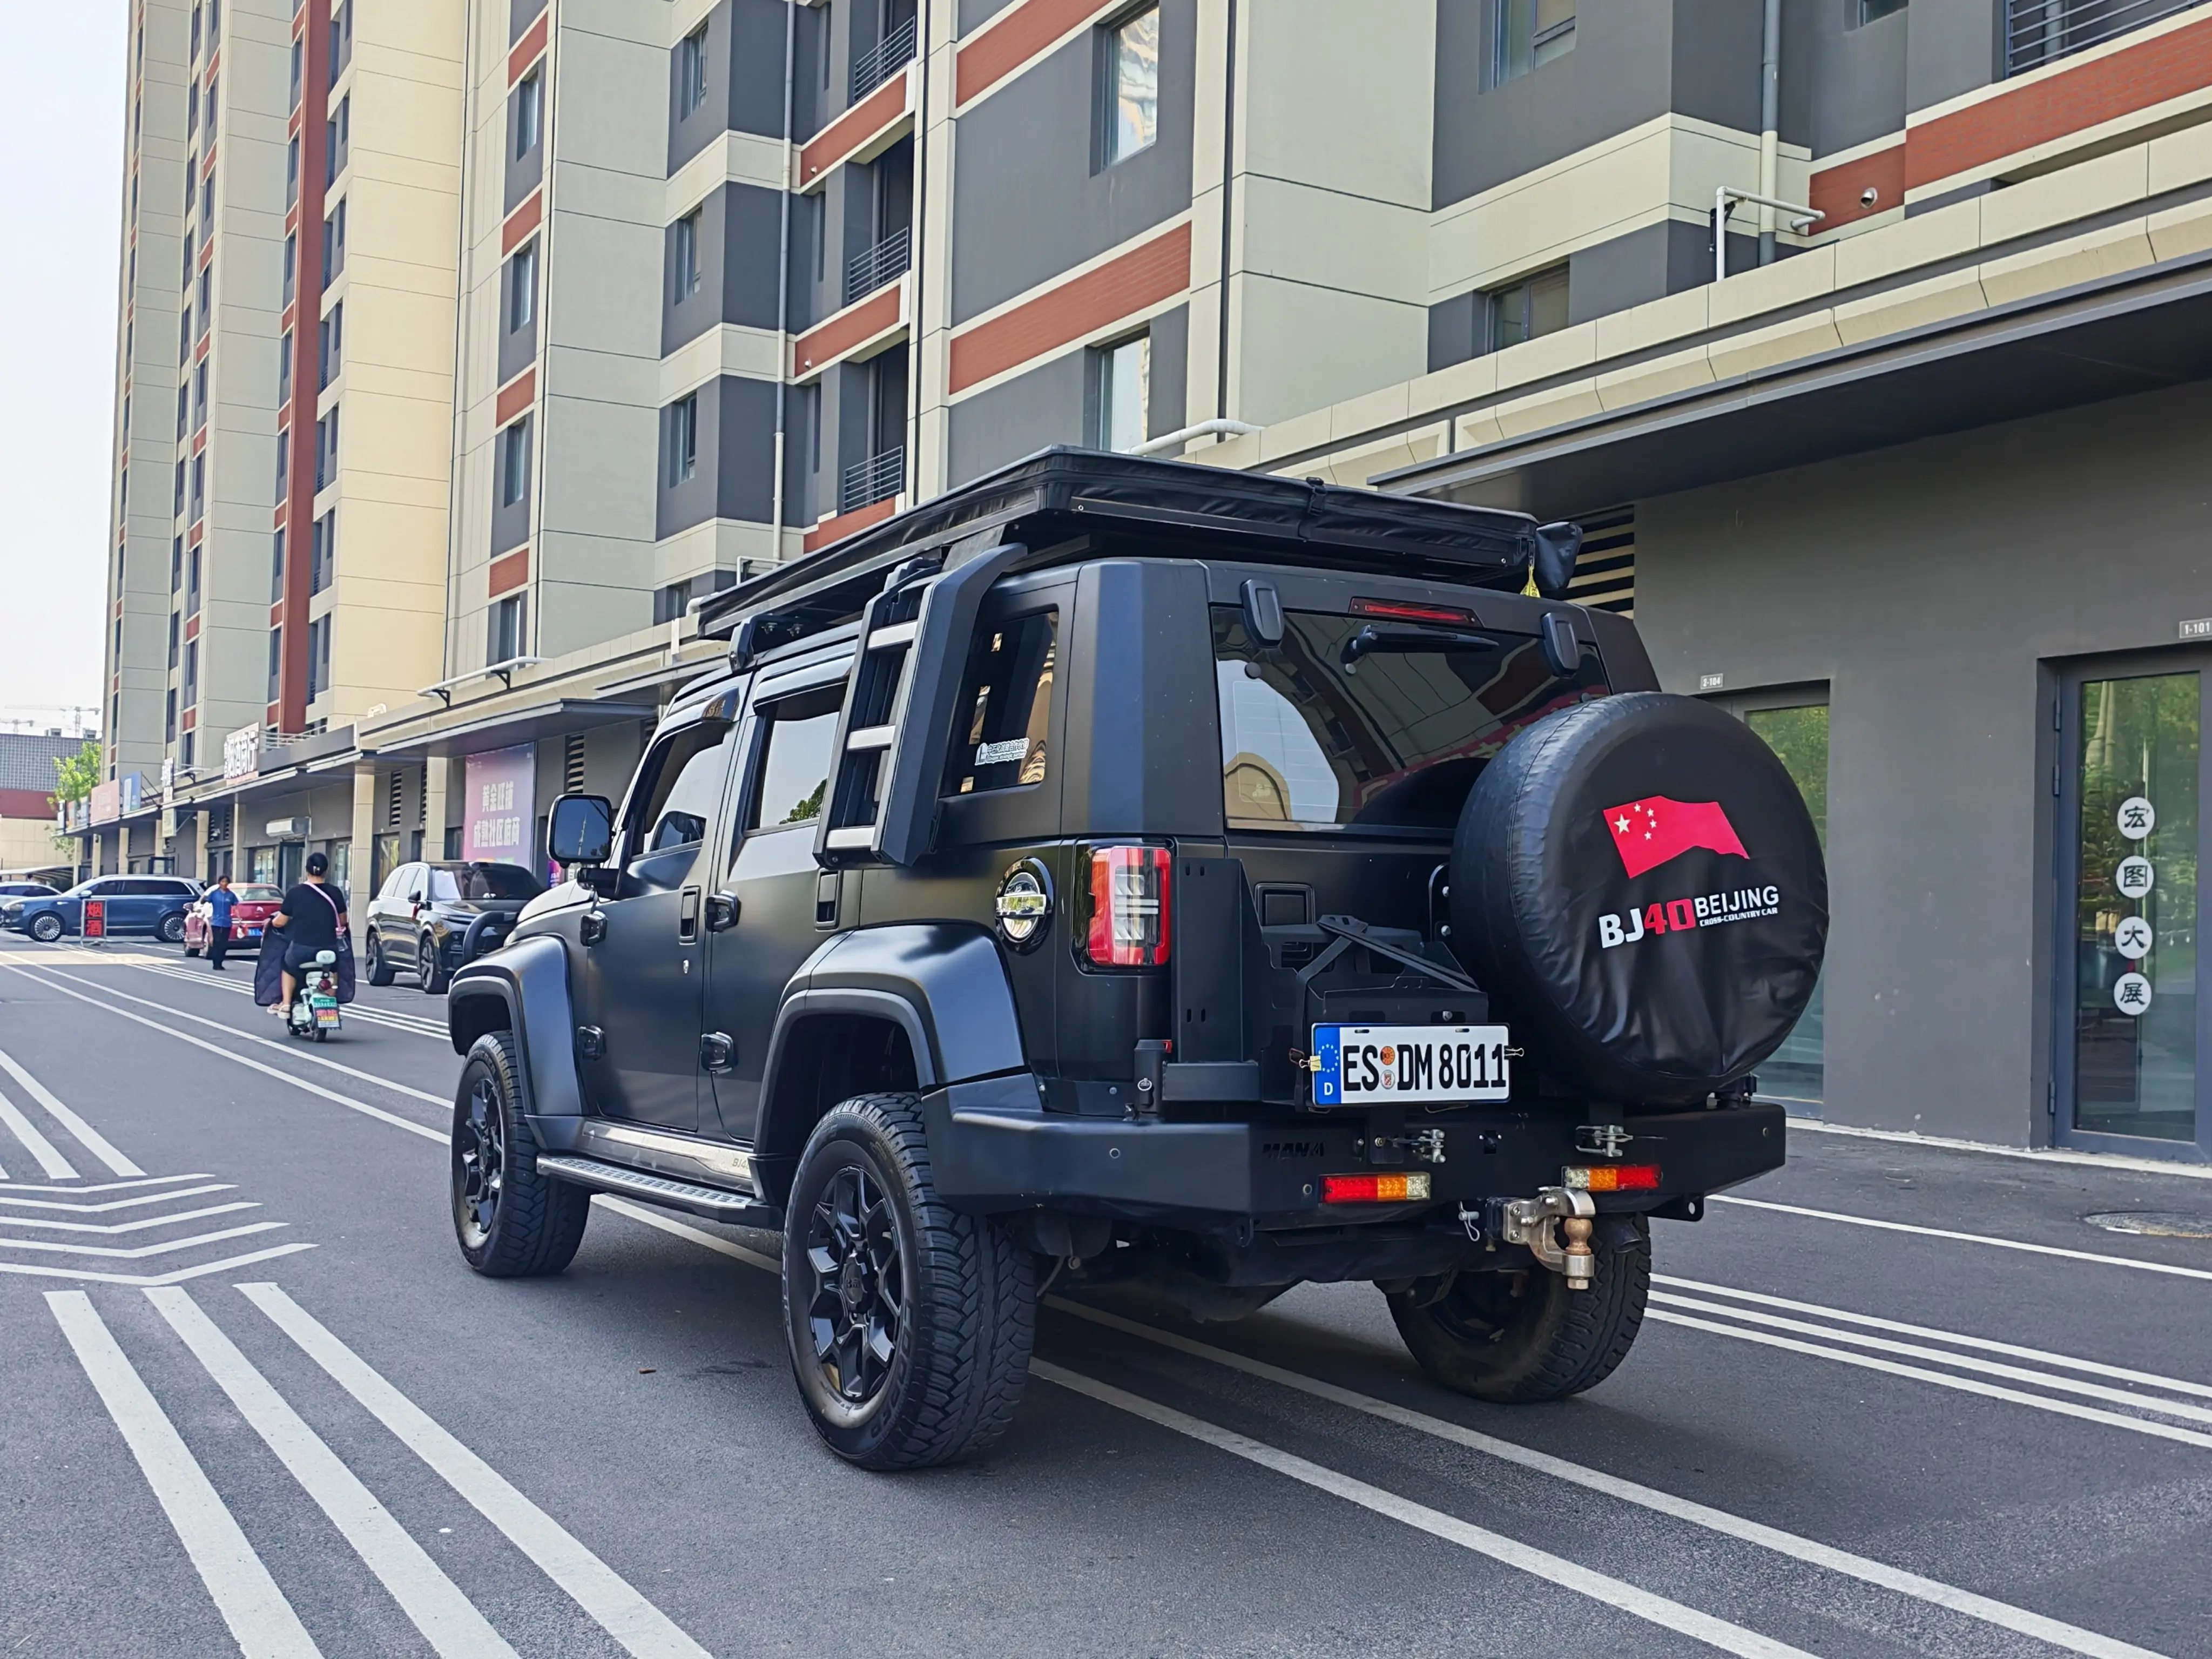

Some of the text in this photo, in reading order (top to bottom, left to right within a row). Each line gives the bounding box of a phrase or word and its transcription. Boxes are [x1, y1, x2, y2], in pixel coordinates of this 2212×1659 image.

[2185, 621, 2210, 635] 1-101
[86, 902, 103, 936] 烟酒
[1599, 886, 1779, 949] BJ40 BEIJING
[1700, 907, 1778, 927] CROSS-COUNTRY CAR
[1343, 1043, 1507, 1091] ES DM 8011
[1324, 1082, 1333, 1095] D
